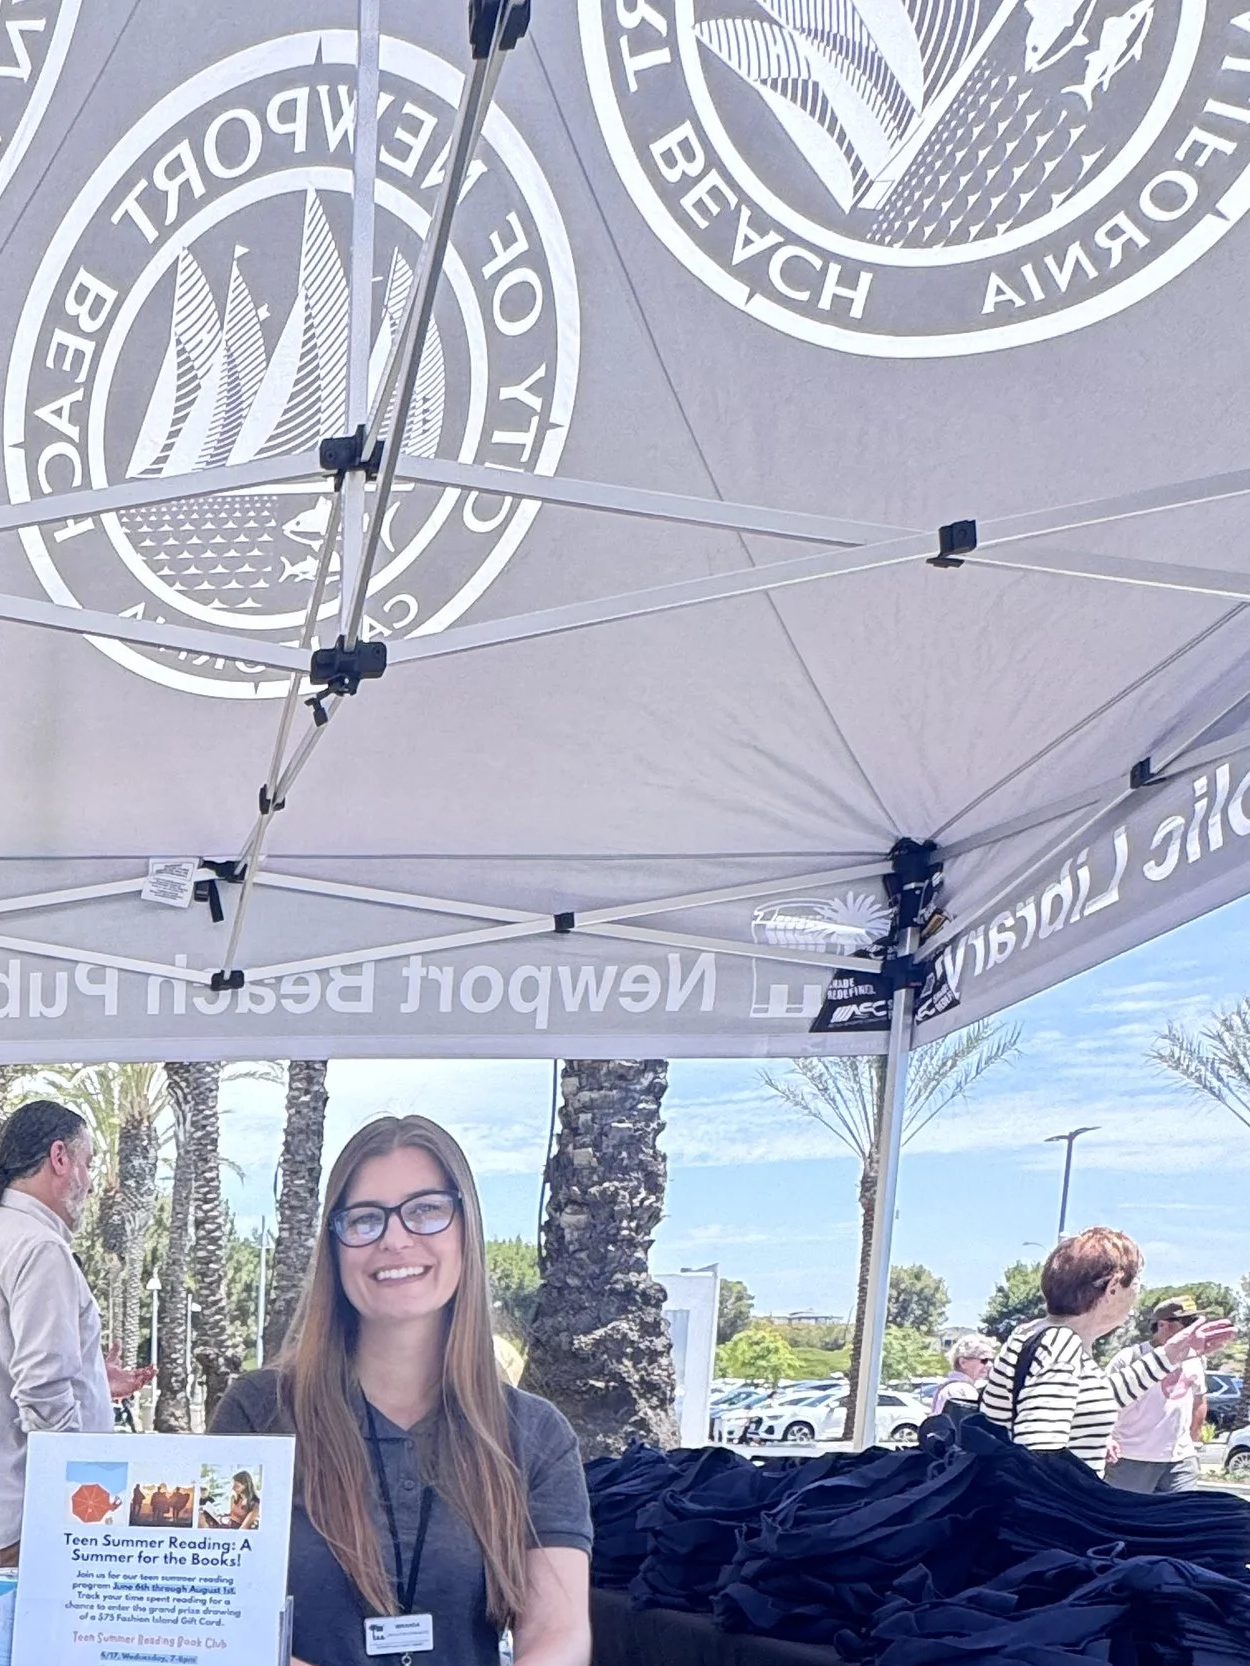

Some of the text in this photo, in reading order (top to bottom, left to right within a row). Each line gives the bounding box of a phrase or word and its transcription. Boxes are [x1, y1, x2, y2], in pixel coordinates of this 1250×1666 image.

[64, 1533, 252, 1554] Teen Summer Reading: A
[72, 1549, 241, 1567] Summer for the Books!
[76, 1570, 94, 1578] Join
[108, 1571, 120, 1580] for
[140, 1573, 159, 1581] teen
[199, 1576, 234, 1586] reading
[72, 1582, 110, 1590] program
[113, 1582, 133, 1591] June
[135, 1583, 150, 1591] 6th
[152, 1584, 187, 1594] through
[189, 1586, 221, 1595] August
[77, 1591, 100, 1600] Track
[103, 1594, 122, 1602] your
[125, 1593, 144, 1601] time
[146, 1595, 170, 1604] spent
[172, 1596, 207, 1605] reading
[209, 1597, 222, 1605] for
[65, 1600, 95, 1610] chance
[107, 1604, 130, 1612] enter
[149, 1605, 176, 1615] grand
[202, 1607, 241, 1618] drawing
[79, 1612, 89, 1620] of
[116, 1614, 150, 1623] Fashion
[152, 1616, 179, 1624] Island
[181, 1617, 197, 1625] Gift
[199, 1617, 224, 1627] Card.
[73, 1631, 227, 1649] Teen Summer Reading Book Club
